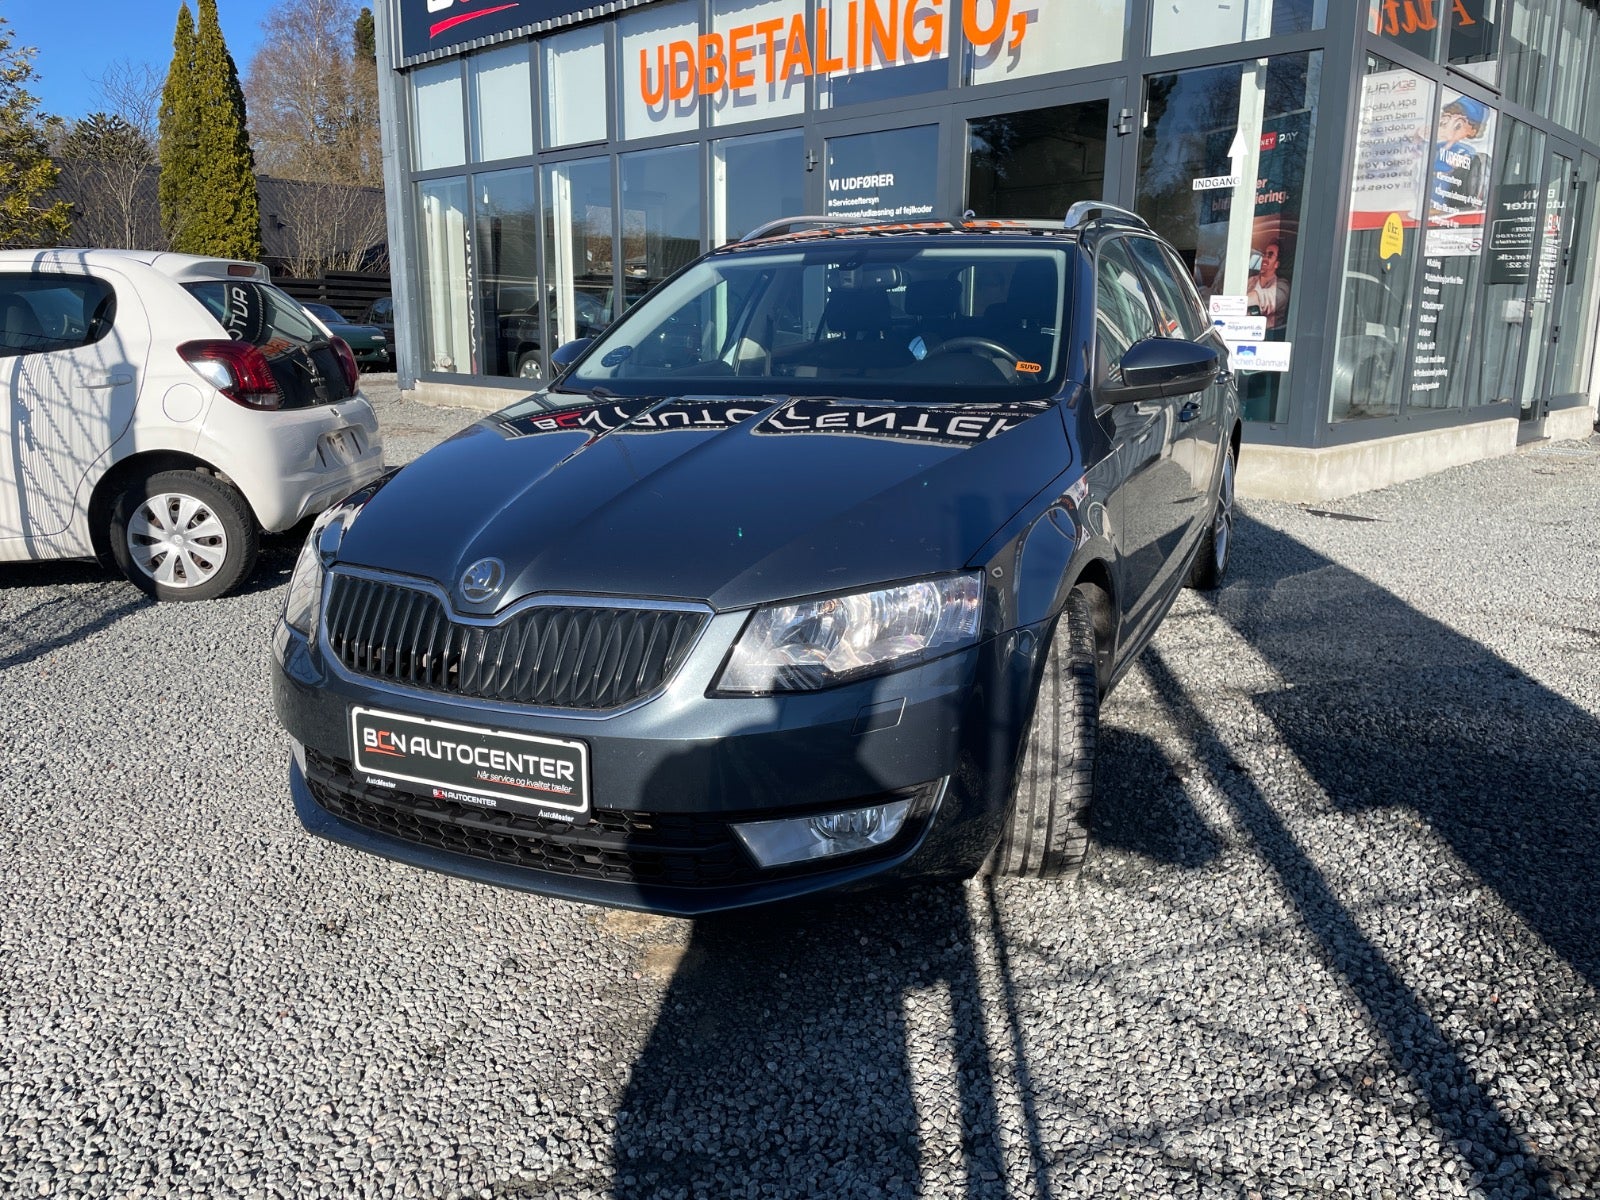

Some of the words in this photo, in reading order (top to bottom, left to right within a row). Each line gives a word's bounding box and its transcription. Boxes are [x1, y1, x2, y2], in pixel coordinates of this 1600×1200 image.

[640, 0, 943, 105] UDBETALING
[829, 179, 839, 191] VI
[841, 173, 894, 190] UDFØRER
[1194, 176, 1240, 189] INDGANG
[363, 727, 406, 753] BCN
[410, 736, 574, 782] AUTOCENTER
[476, 770, 489, 779] Når
[490, 773, 515, 784] service
[515, 778, 526, 788] og
[526, 778, 550, 790] kvalitet
[551, 782, 573, 794] tæller
[432, 788, 448, 798] BCN
[447, 792, 497, 807] AUTOCENTER
[538, 810, 574, 823] AutoMester
